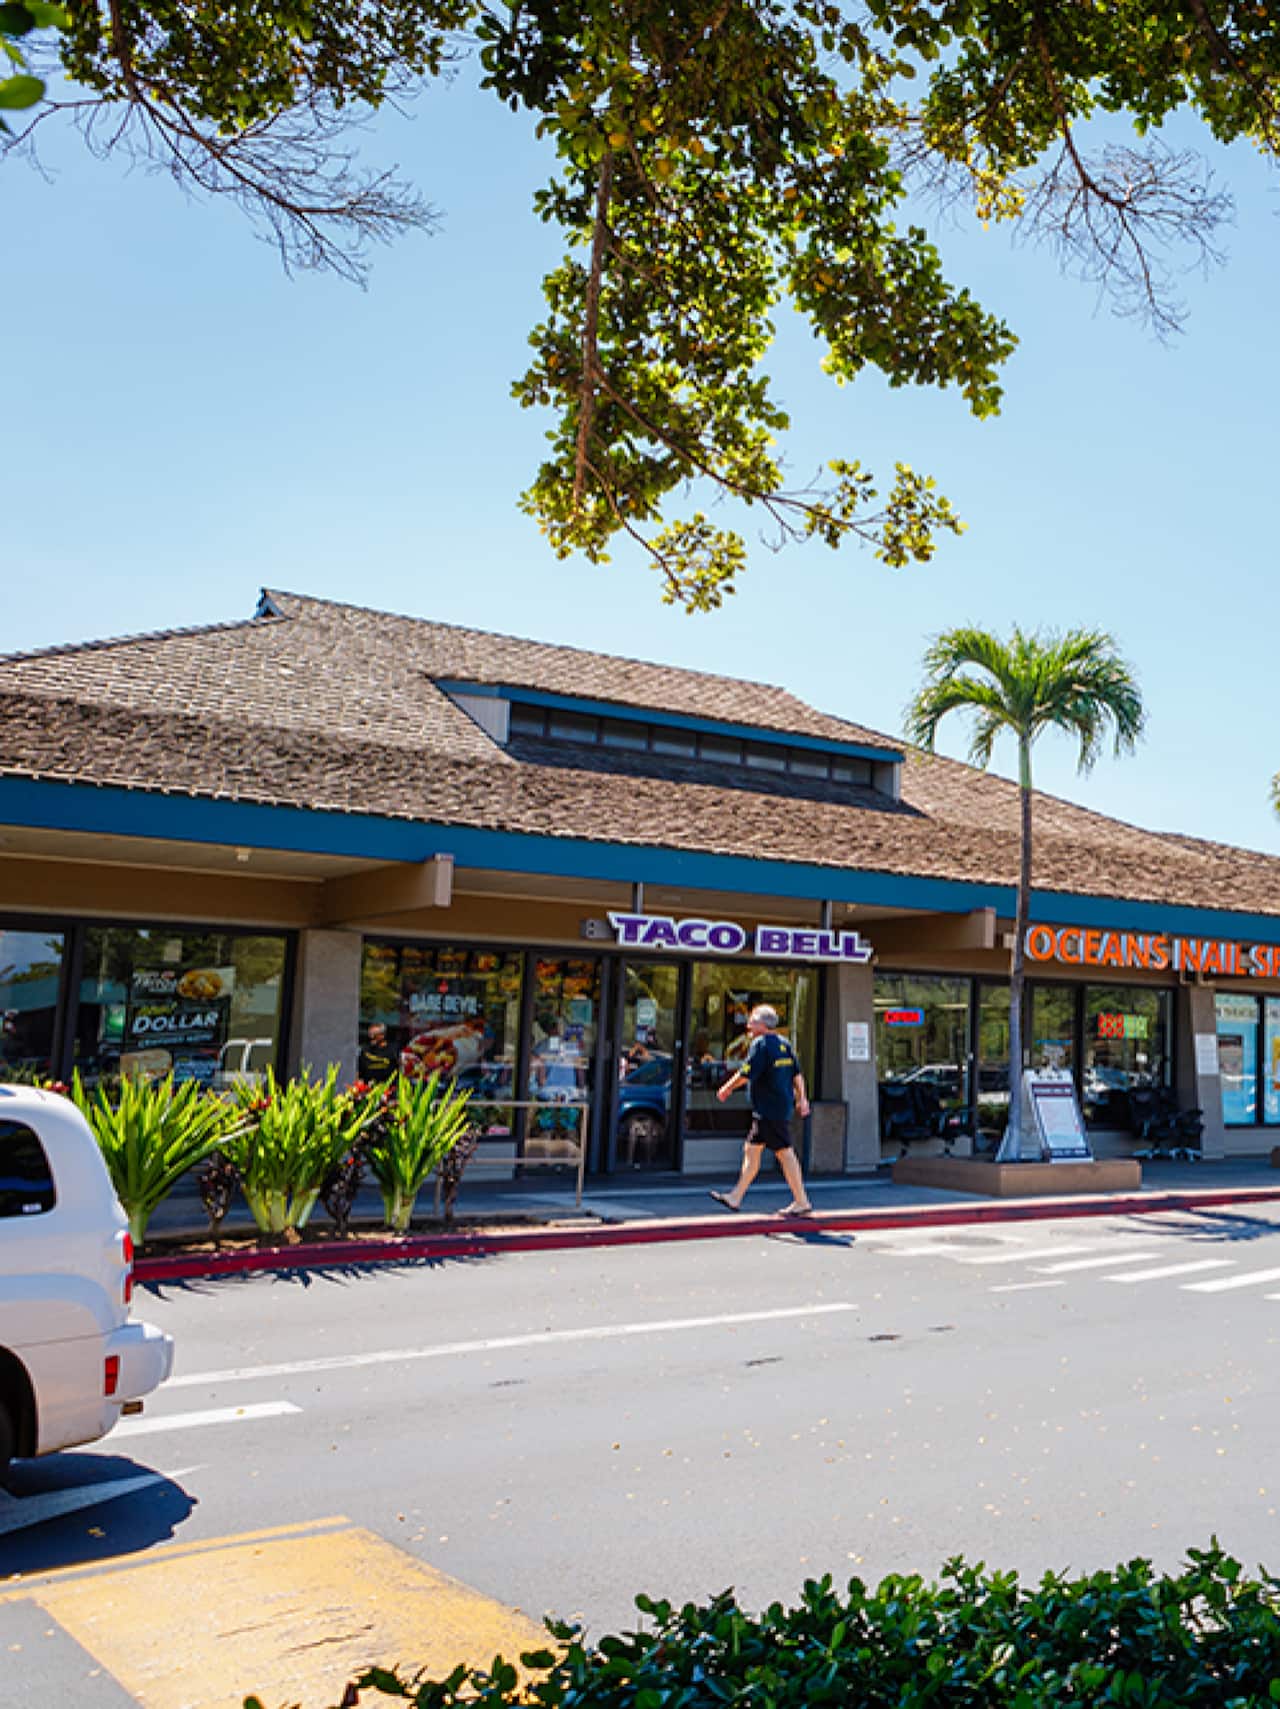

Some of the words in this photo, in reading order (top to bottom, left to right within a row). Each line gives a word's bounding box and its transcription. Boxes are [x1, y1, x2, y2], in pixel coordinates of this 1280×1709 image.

[607, 912, 745, 953] TACO
[755, 925, 873, 962] BELL
[1025, 925, 1169, 969] OCEANS
[1173, 938, 1247, 976] NAIL
[132, 1010, 219, 1034] DOLLAR
